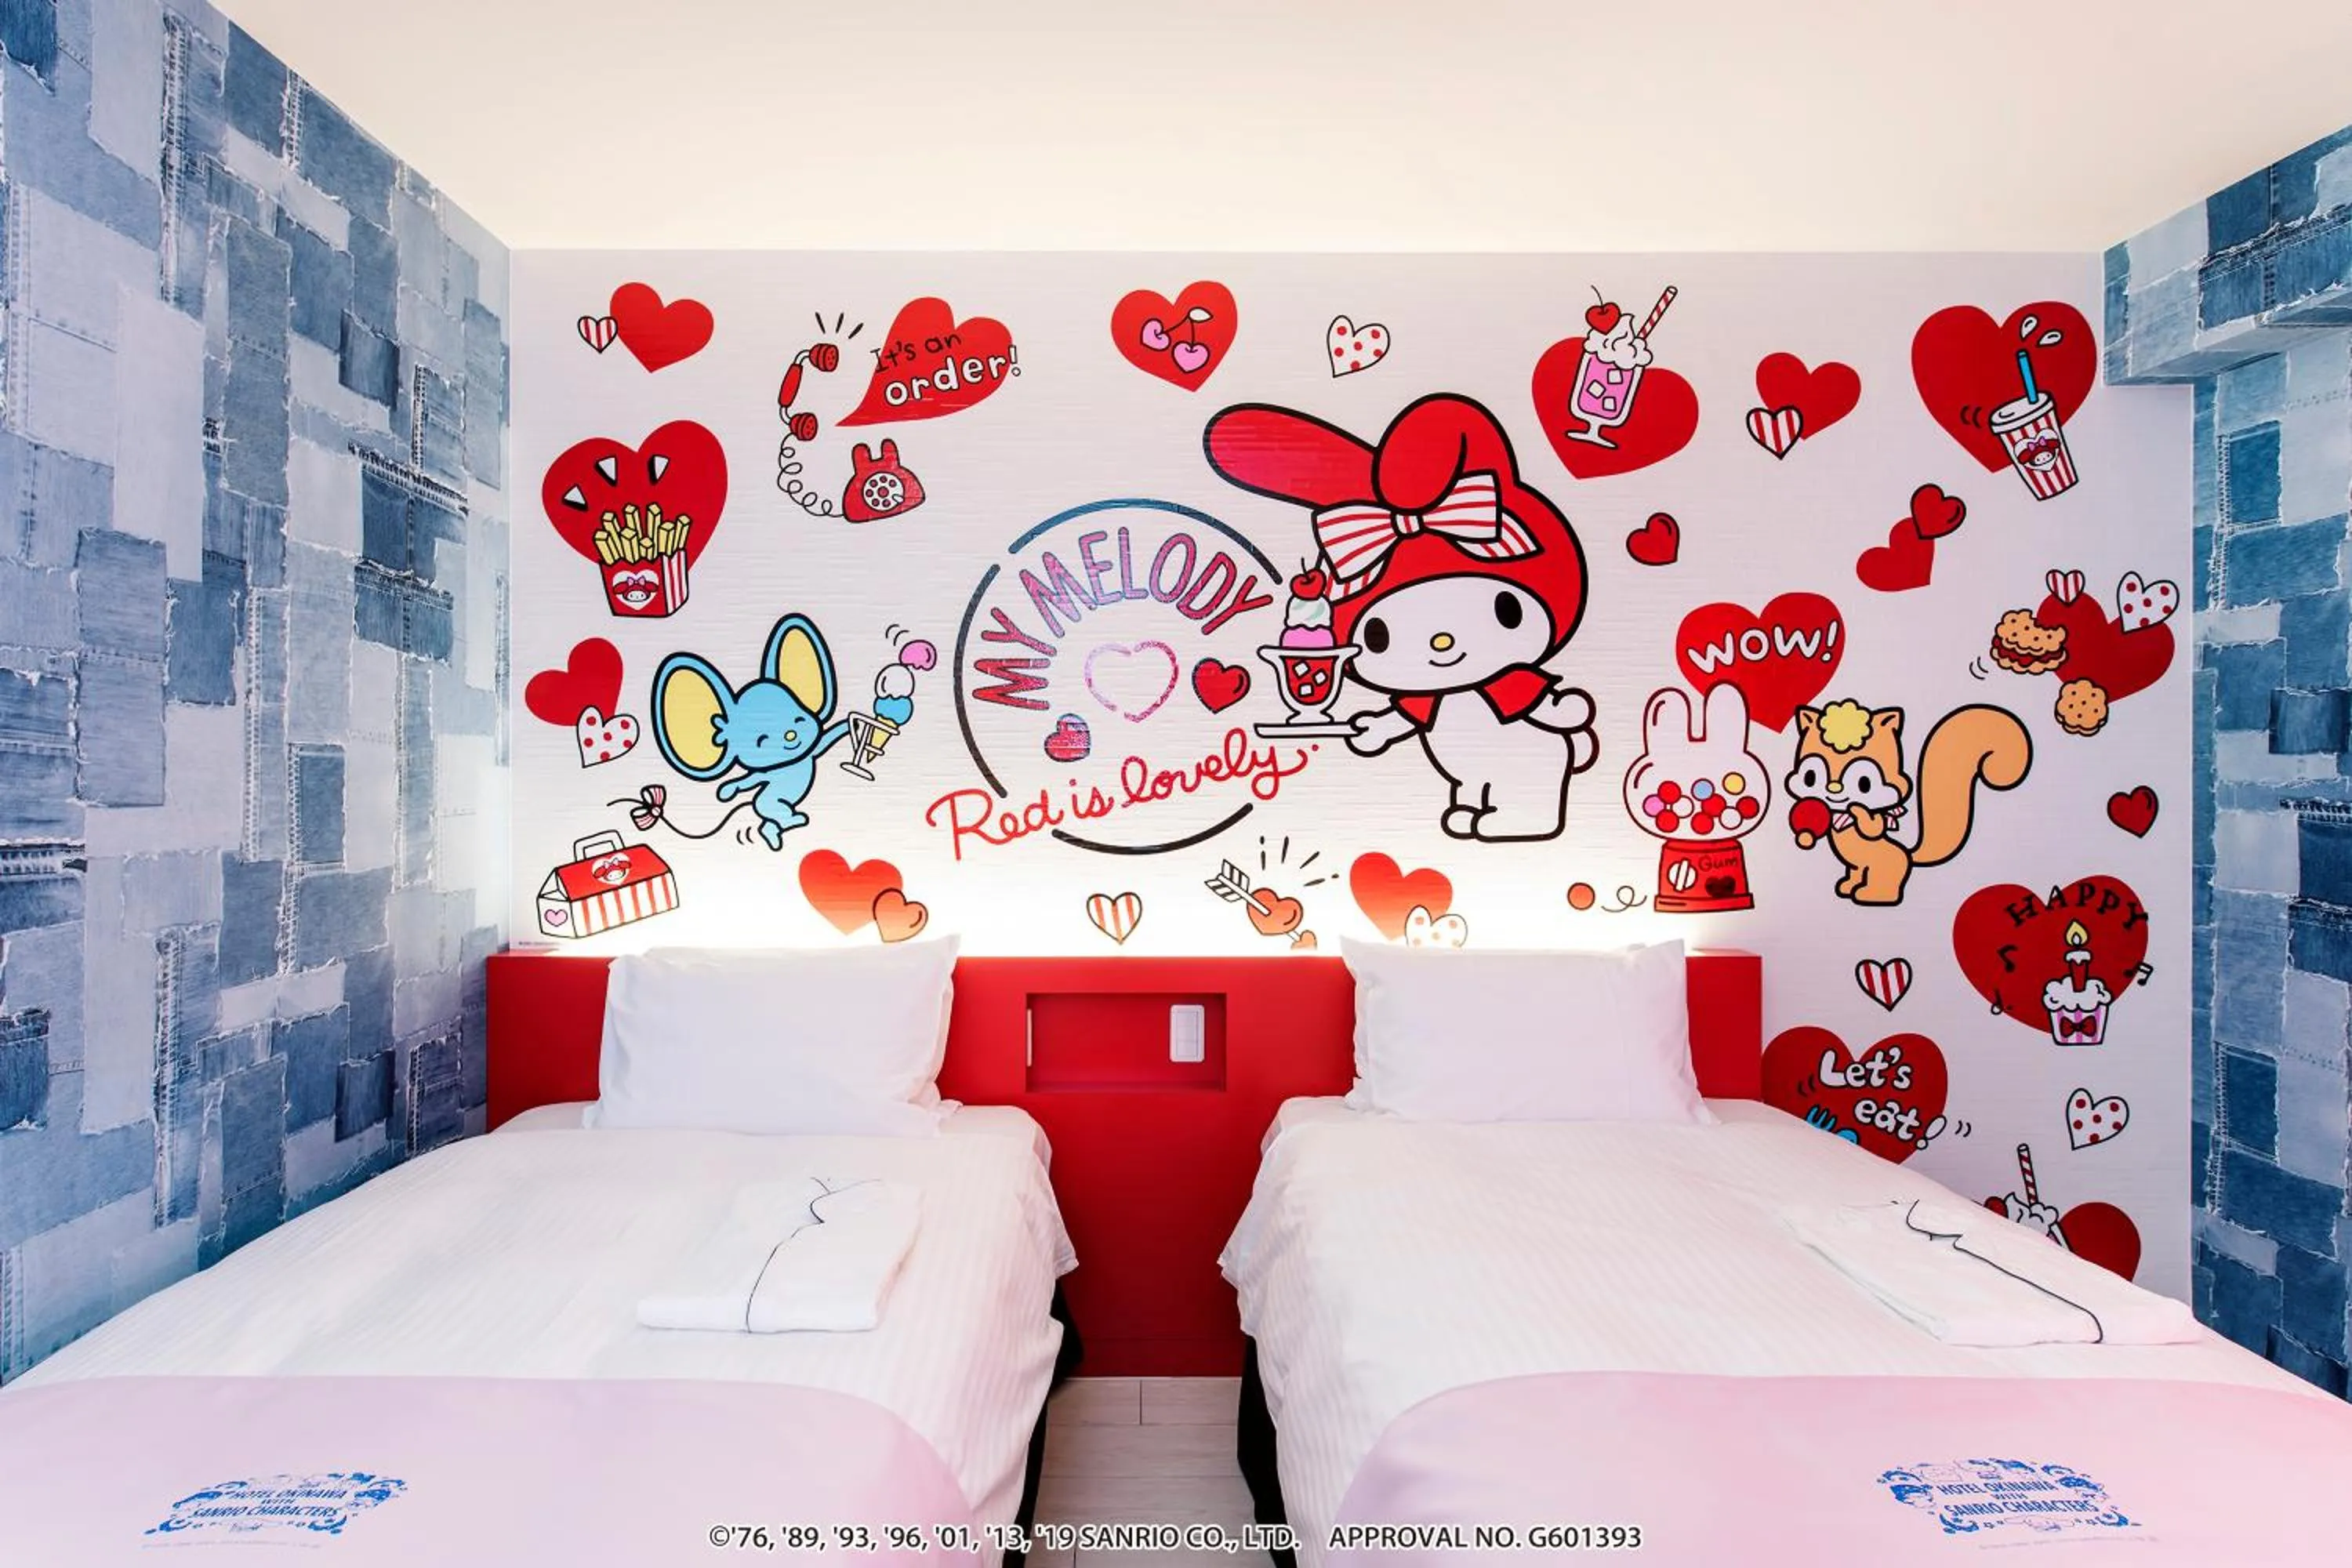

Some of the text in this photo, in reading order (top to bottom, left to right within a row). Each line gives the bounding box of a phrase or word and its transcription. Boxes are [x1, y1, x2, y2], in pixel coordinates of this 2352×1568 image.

[870, 332, 962, 372] It's an
[884, 345, 1022, 406] order!
[972, 527, 1274, 710] MY MELODY
[925, 728, 1309, 862] Red is lovely
[1698, 855, 1738, 873] Gum
[2005, 882, 2149, 931] HAPPY
[1818, 1046, 1914, 1090] Let's
[1853, 1099, 1947, 1150] eat!
[1936, 1483, 1987, 1495] HOTEL
[1944, 1500, 2100, 1516] SANRIO CHARACTERS
